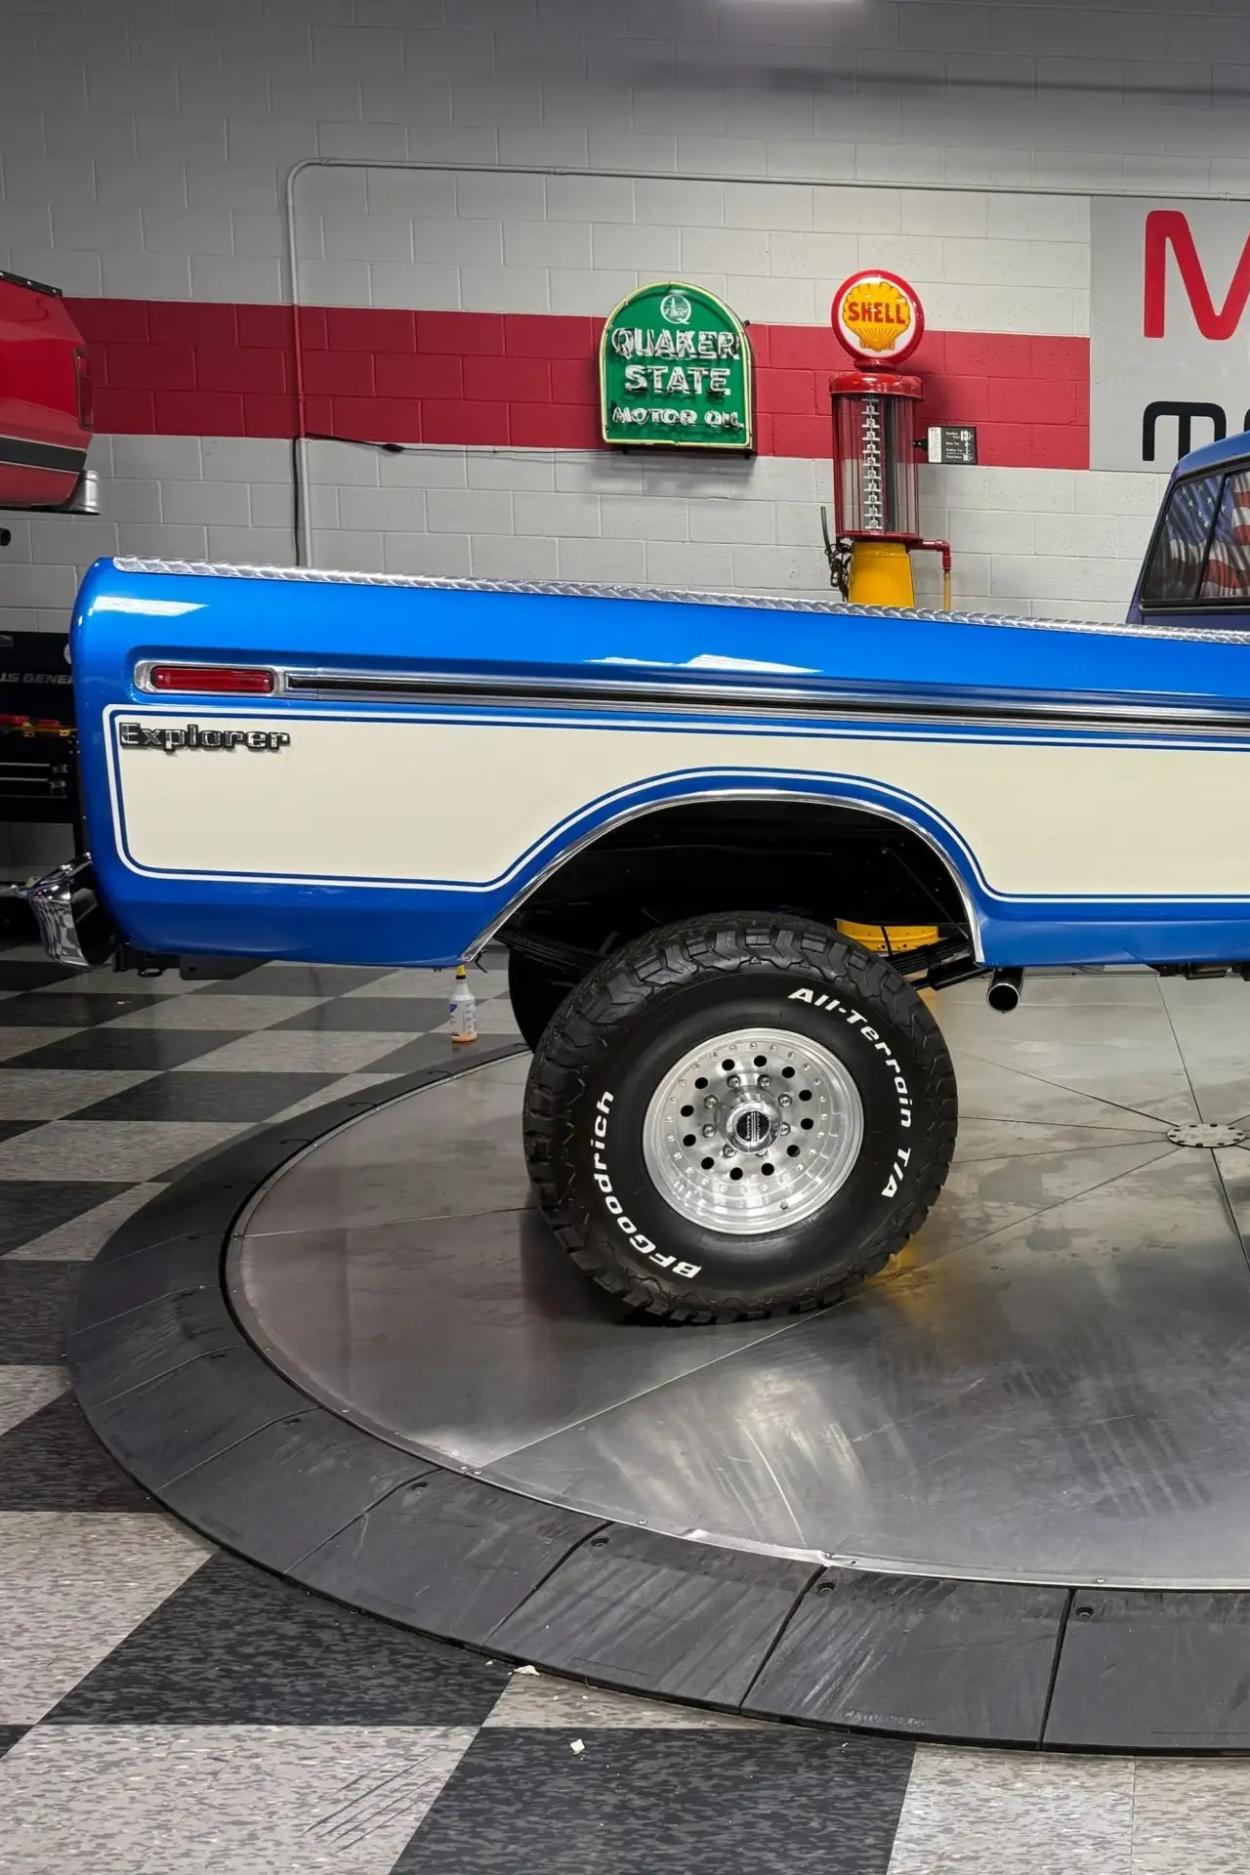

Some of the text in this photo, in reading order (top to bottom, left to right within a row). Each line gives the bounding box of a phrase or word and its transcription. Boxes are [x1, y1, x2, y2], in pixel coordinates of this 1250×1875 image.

[847, 301, 906, 325] SHELL
[612, 328, 740, 360] QUAKER
[625, 365, 731, 396] STATE
[612, 407, 698, 426] MOTOR
[119, 722, 290, 753] Explorer
[788, 988, 912, 1197] All-Terrain T/A
[591, 1091, 702, 1279] BFGoodrich
